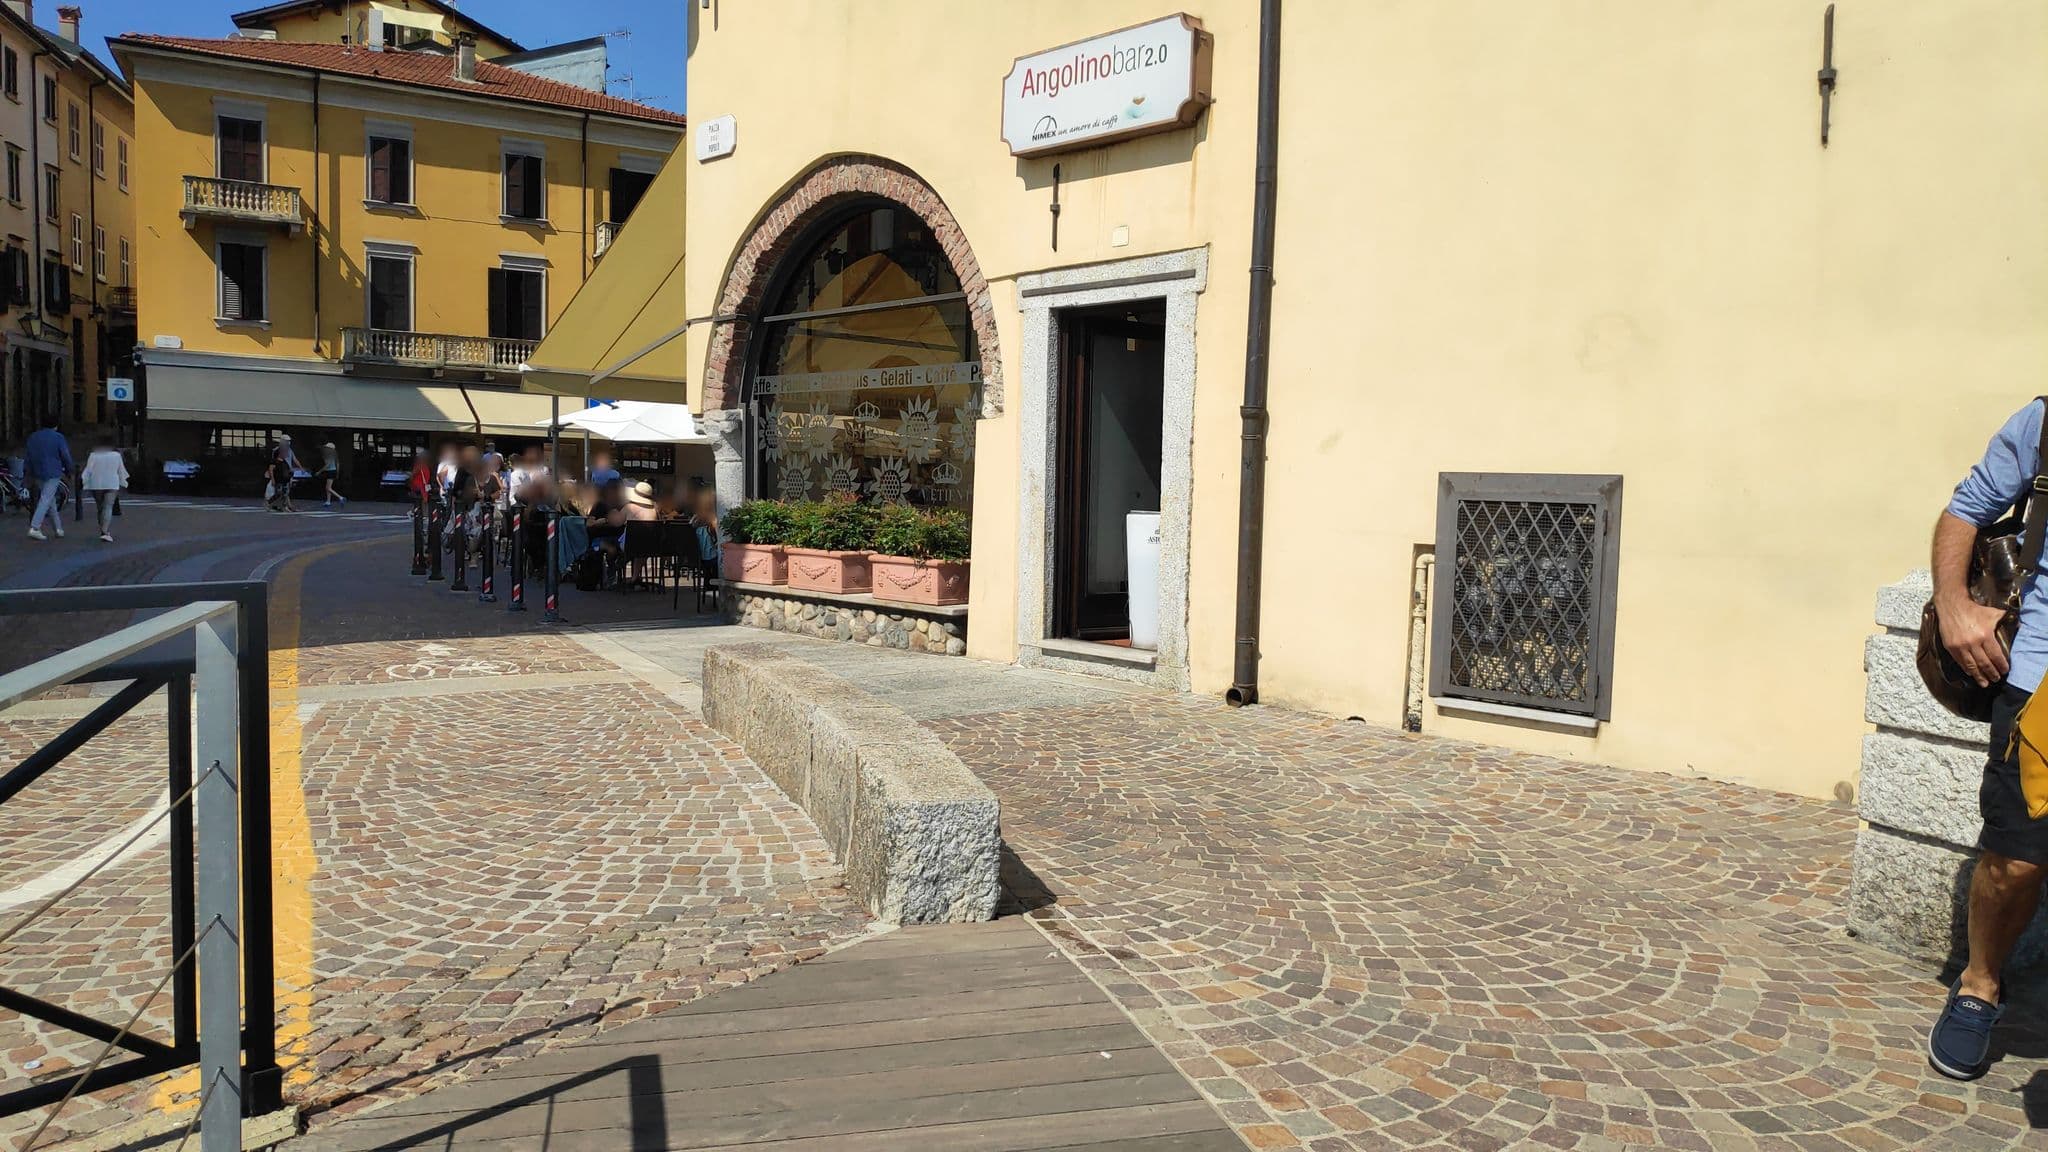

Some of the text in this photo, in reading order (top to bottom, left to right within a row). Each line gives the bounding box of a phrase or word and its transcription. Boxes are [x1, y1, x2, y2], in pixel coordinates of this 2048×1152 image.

[1032, 131, 1057, 142] NIMEX
[1069, 124, 1091, 133] amore
[1092, 119, 1100, 128] di
[880, 368, 913, 386] Gelati
